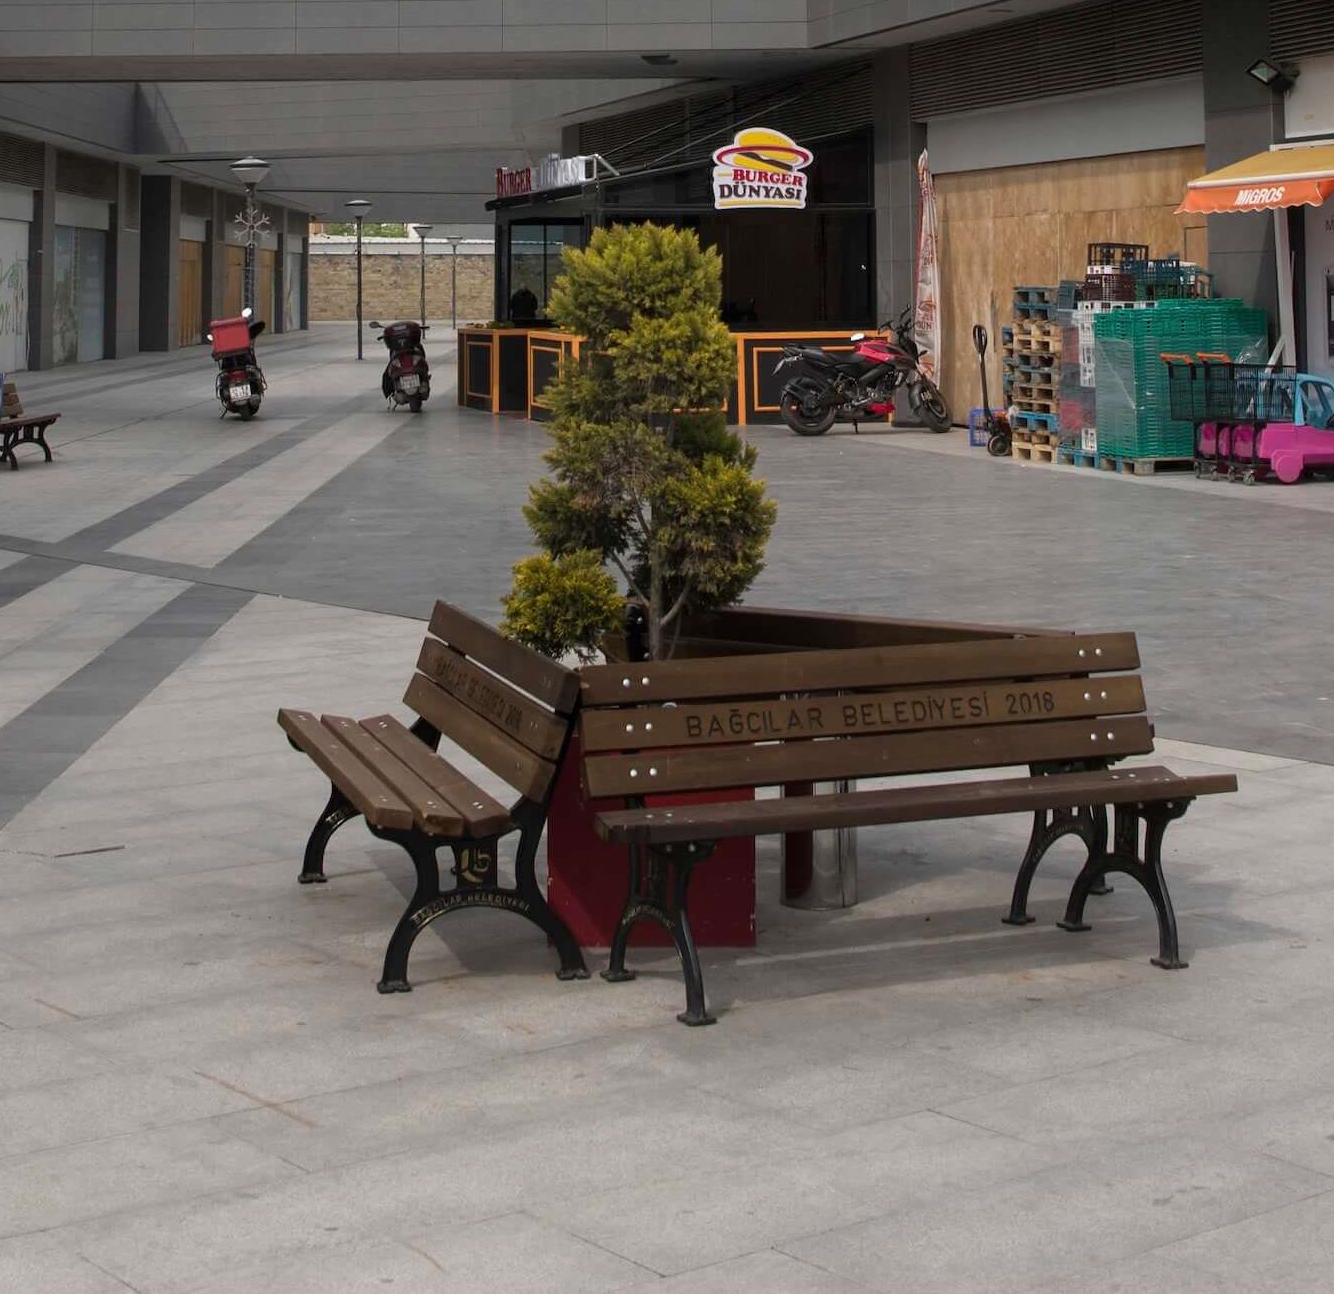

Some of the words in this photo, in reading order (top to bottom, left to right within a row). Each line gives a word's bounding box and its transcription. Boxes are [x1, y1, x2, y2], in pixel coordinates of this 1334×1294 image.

[733, 169, 803, 186] BURGER
[719, 181, 802, 200] DÜNYASI
[1234, 186, 1286, 206] MiGROS
[686, 709, 823, 738] BAĞCILAR
[843, 691, 988, 727] BELEDİYESİ
[1006, 691, 1055, 716] 2018
